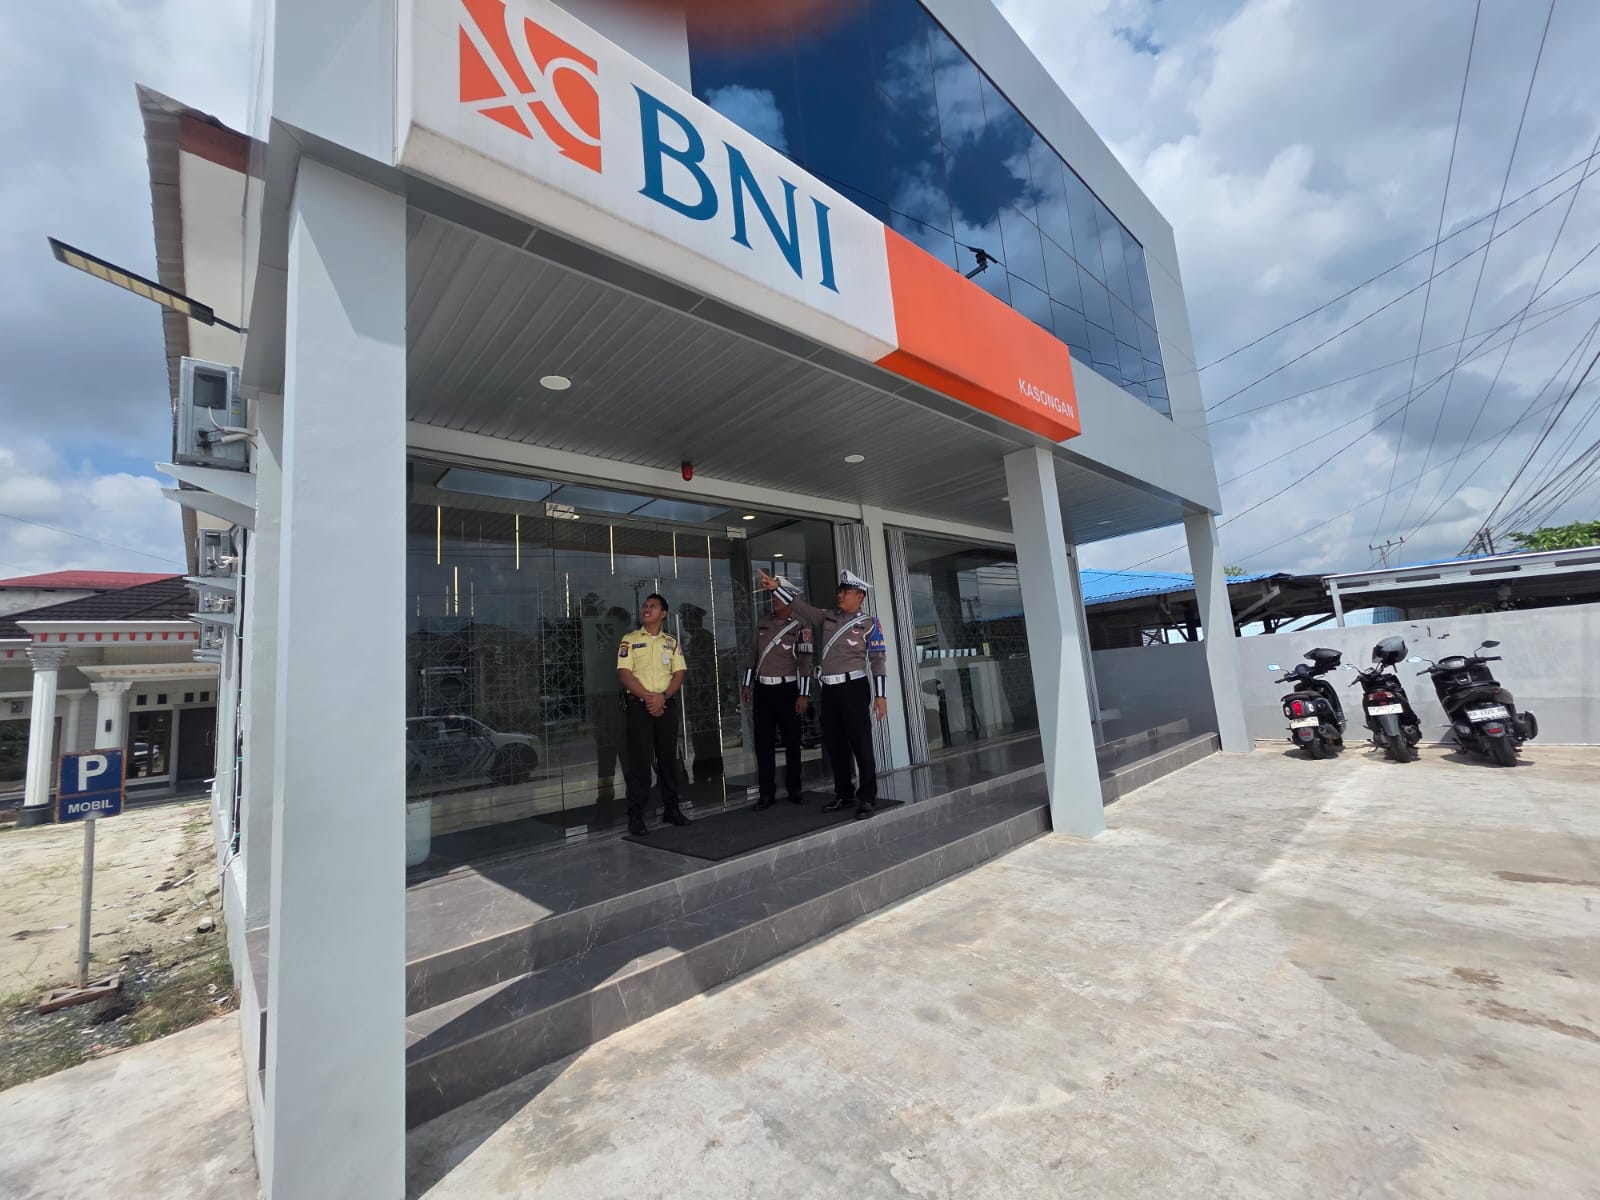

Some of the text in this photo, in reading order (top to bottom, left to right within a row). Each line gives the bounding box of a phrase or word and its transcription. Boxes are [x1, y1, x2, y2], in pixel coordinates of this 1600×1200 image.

[631, 83, 839, 294] BNI
[1018, 378, 1075, 419] KASONGAN
[78, 754, 108, 791] P
[67, 799, 114, 814] MOBIL
